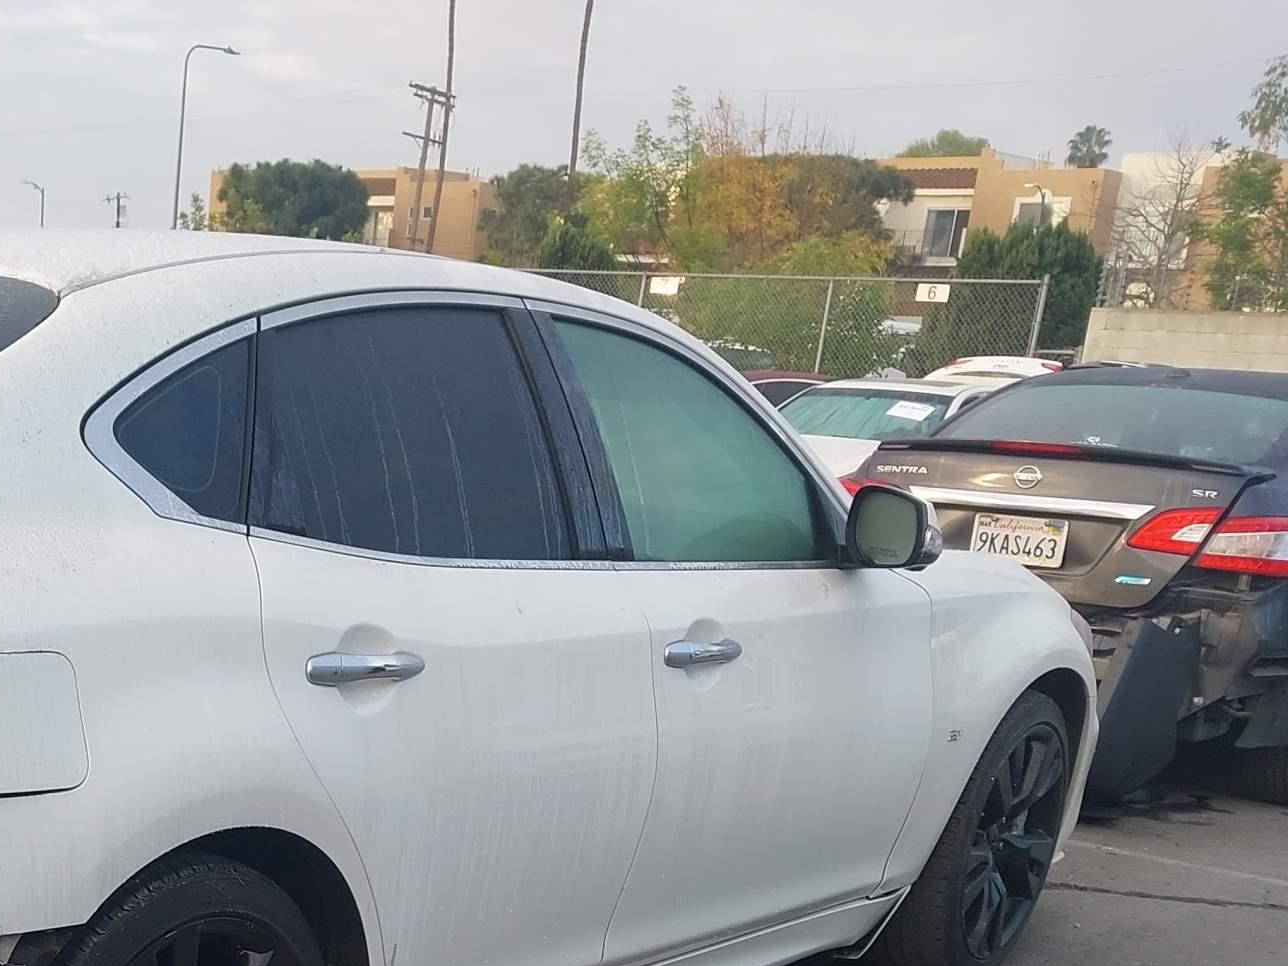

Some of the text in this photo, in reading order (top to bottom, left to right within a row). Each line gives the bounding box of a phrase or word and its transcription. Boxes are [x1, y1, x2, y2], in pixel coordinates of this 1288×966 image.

[927, 285, 938, 300] 6
[876, 464, 928, 475] SENTRA
[1192, 488, 1218, 499] SR
[993, 517, 1048, 534] California
[976, 531, 1058, 560] 9KAS463
